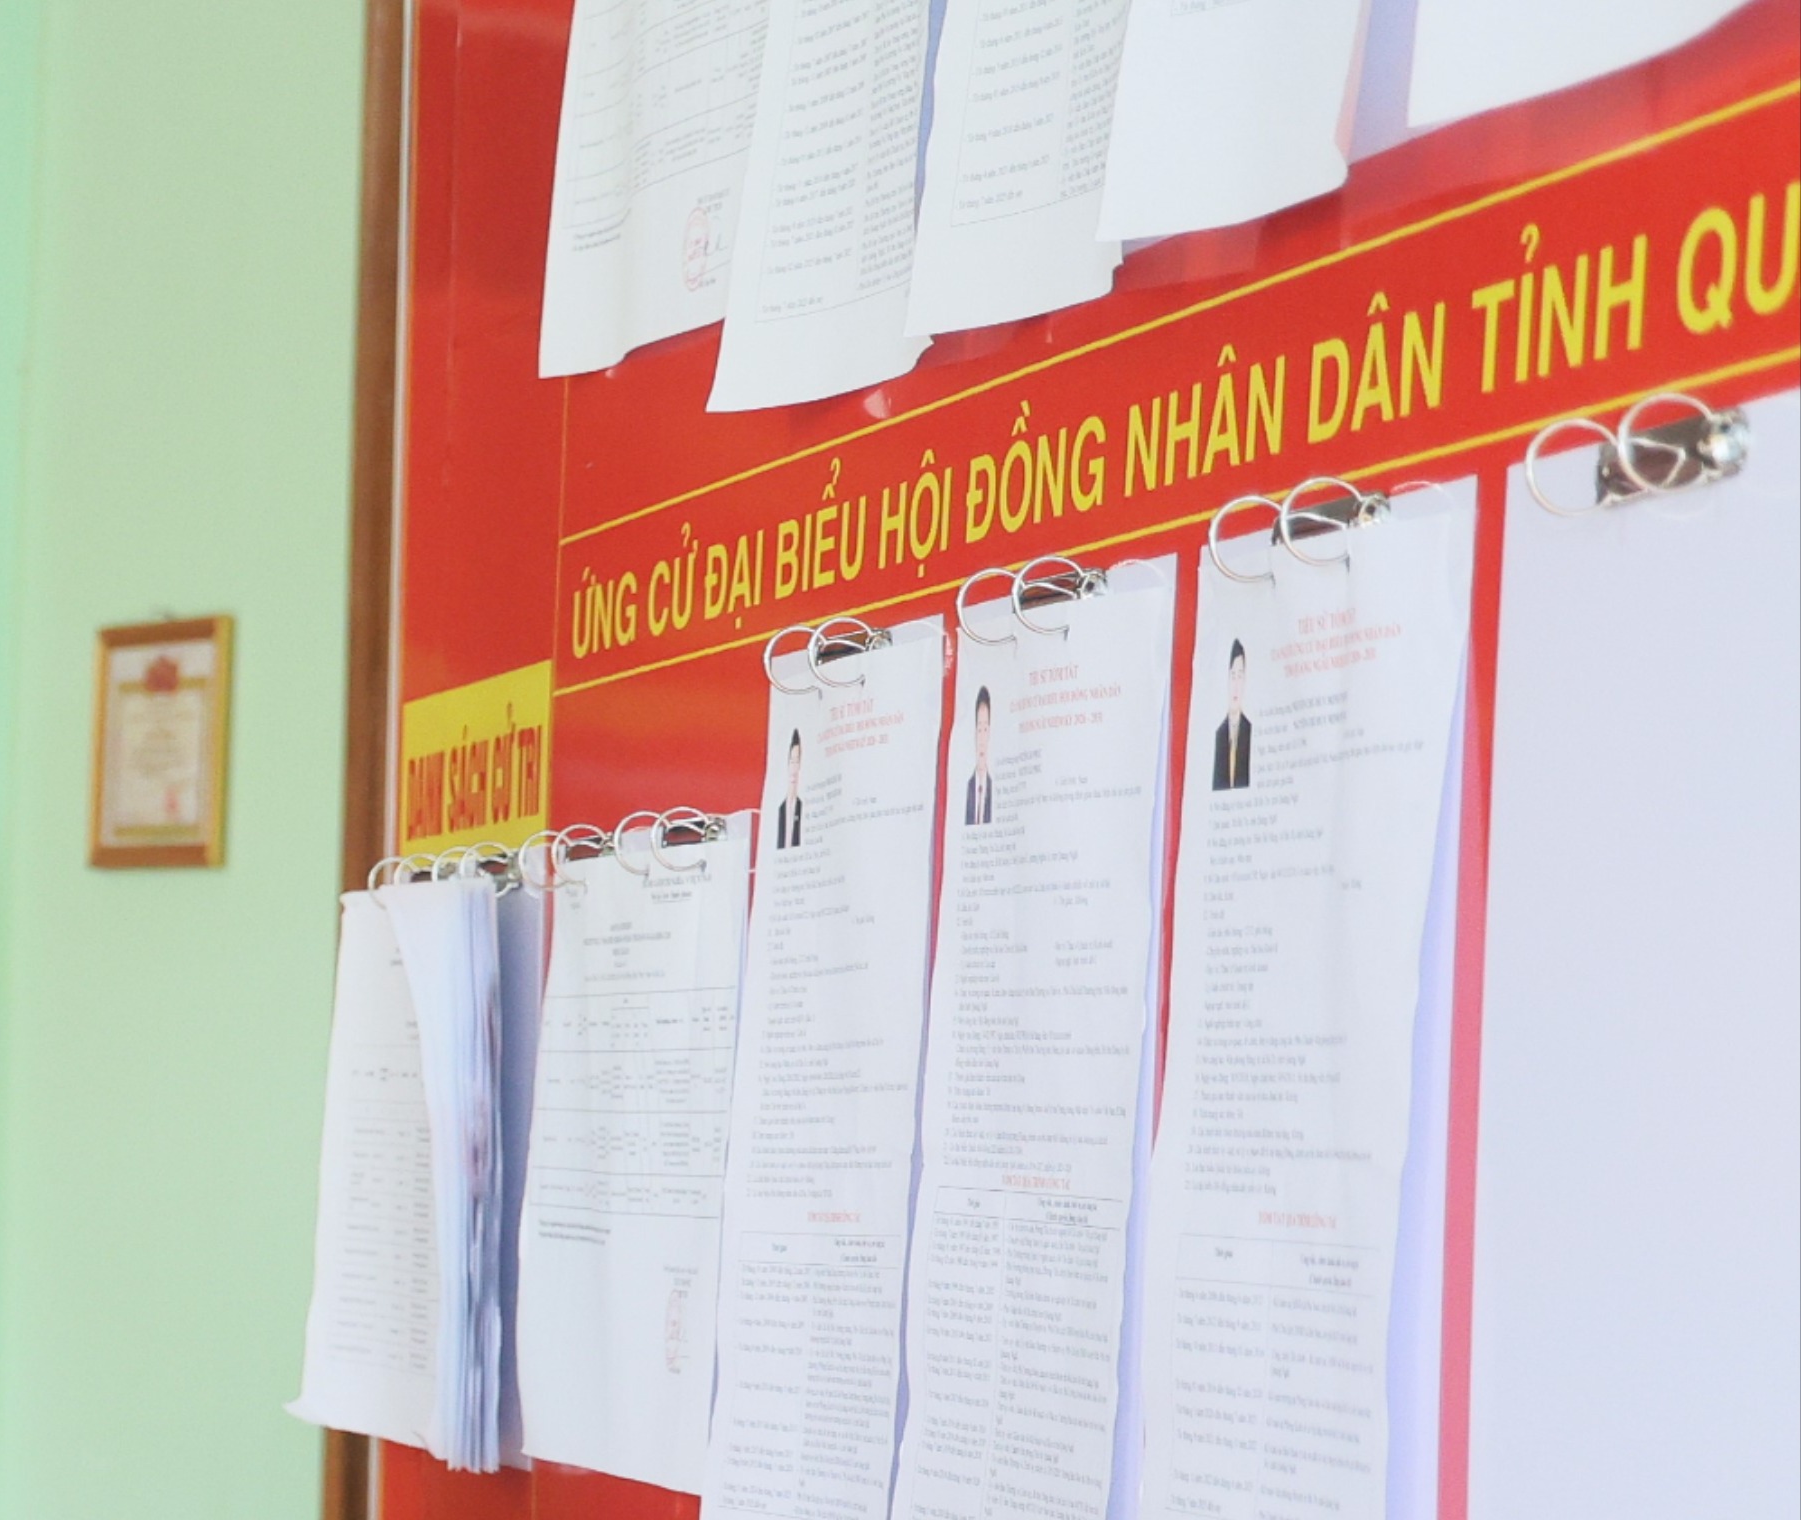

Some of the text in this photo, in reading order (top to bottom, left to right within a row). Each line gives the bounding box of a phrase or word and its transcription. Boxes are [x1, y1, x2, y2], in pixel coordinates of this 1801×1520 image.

[572, 557, 638, 659] ỨNG
[647, 522, 698, 630] CỬ
[704, 527, 765, 629] ĐẠI
[774, 457, 866, 600] BIỂU
[878, 449, 954, 578] HỘI
[964, 400, 1107, 544] ĐỒNG
[1123, 343, 1287, 499] NHÂN
[1307, 291, 1445, 444] DÂN
[1471, 223, 1648, 393] TỈNH
